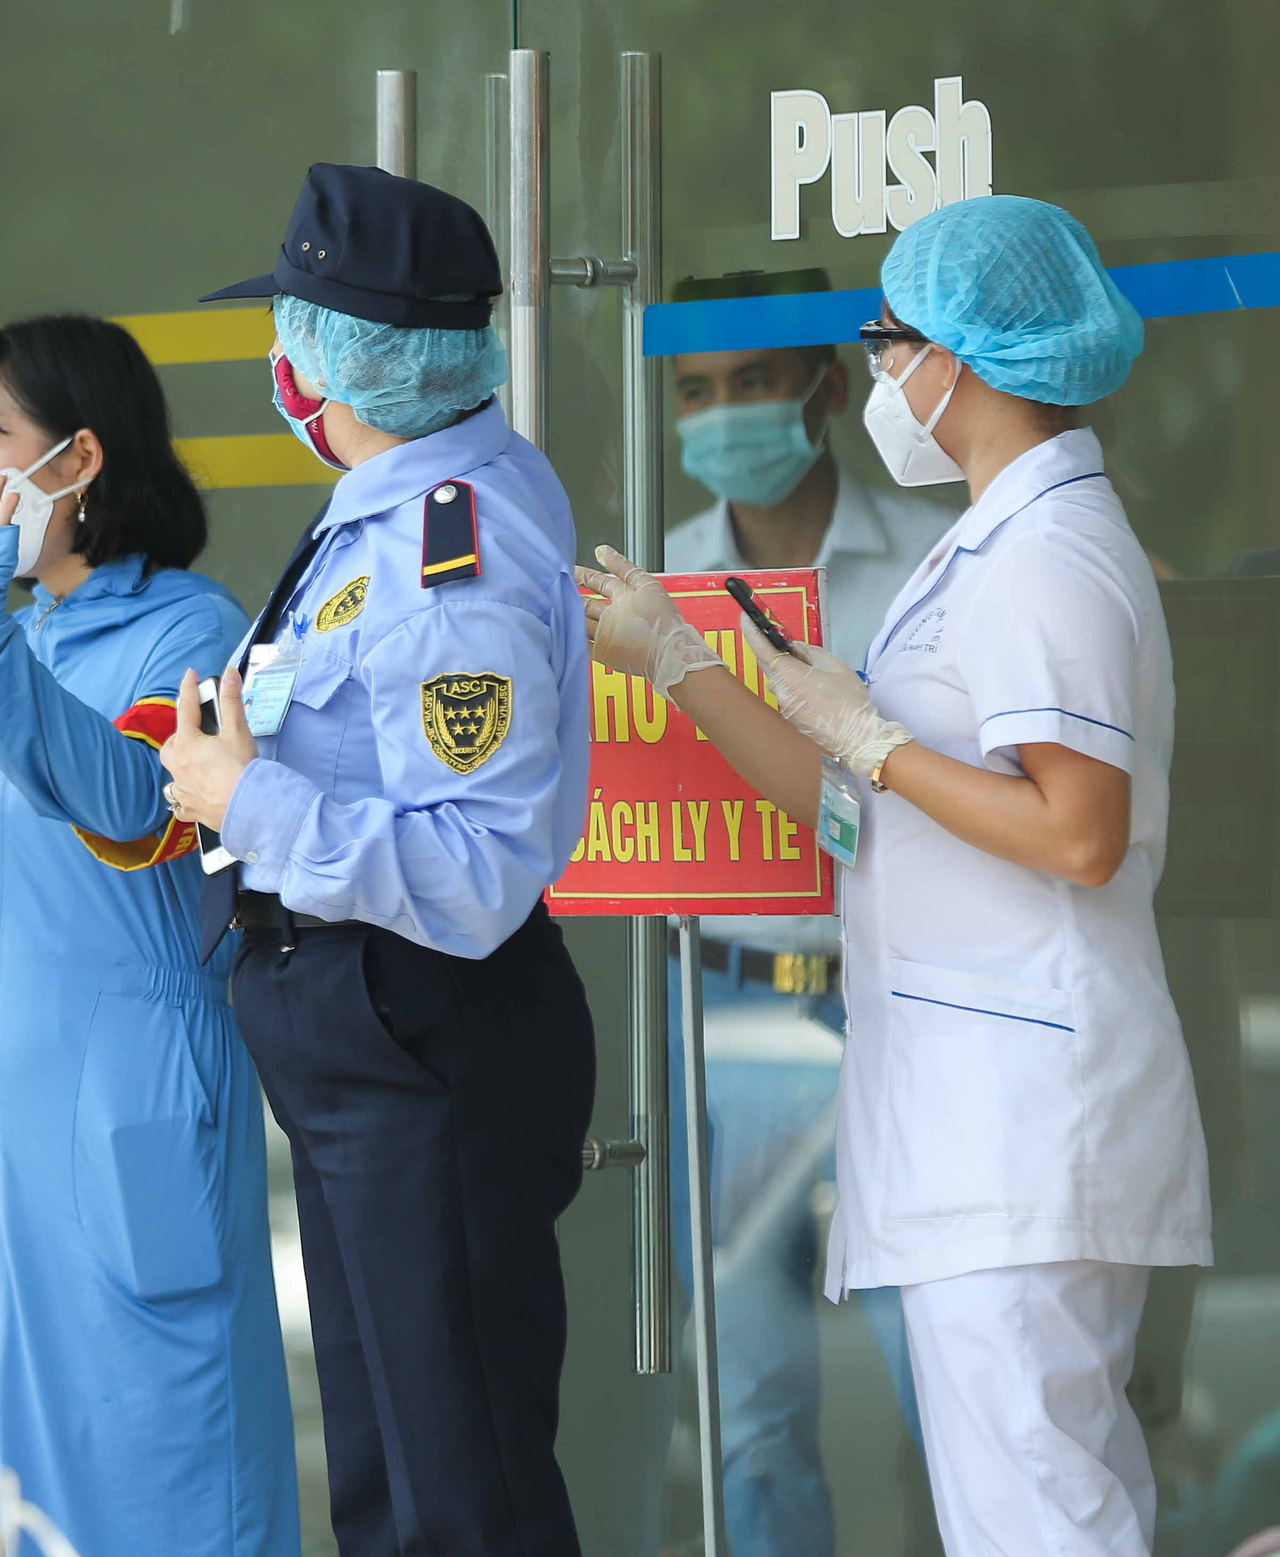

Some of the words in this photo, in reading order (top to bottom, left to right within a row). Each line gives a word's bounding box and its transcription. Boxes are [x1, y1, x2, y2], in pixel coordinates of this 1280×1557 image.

[770, 75, 993, 241] Push
[450, 680, 480, 694] ASC
[588, 659, 668, 744] HU
[569, 787, 661, 863] ÁCH
[670, 800, 710, 863] LY
[721, 799, 745, 862] Y
